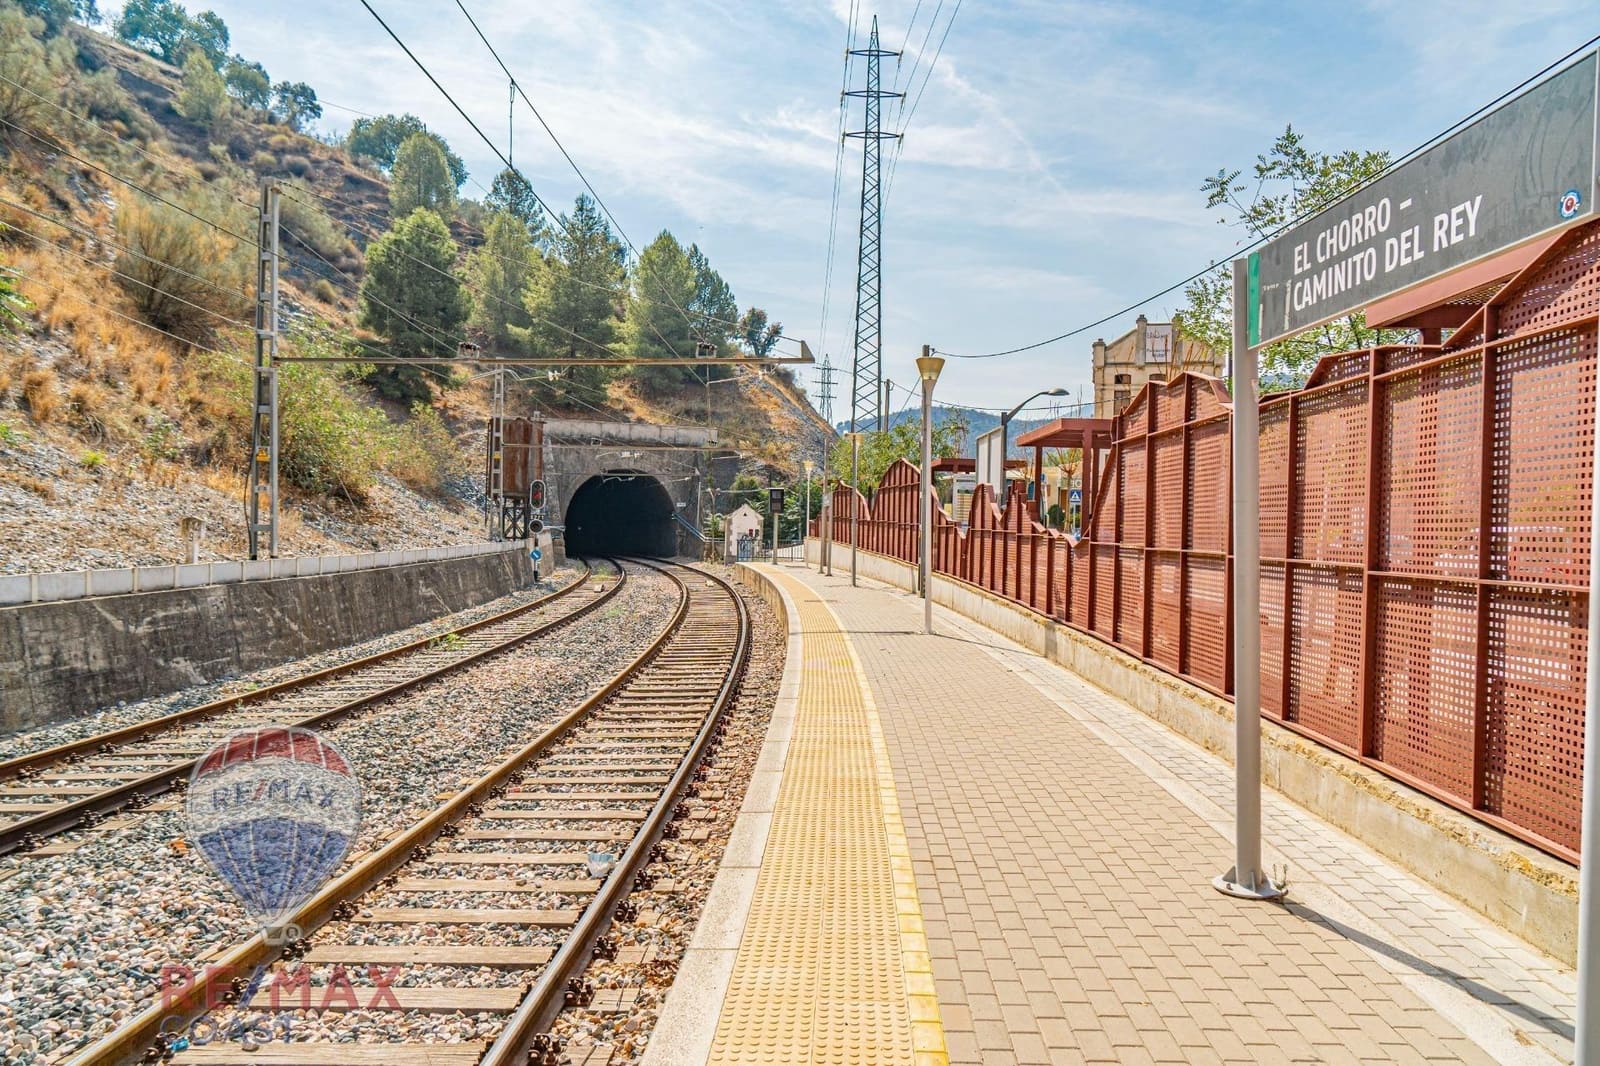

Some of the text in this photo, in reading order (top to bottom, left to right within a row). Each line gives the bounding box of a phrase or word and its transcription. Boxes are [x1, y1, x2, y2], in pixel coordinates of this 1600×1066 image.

[1293, 243, 1311, 276] EL
[1316, 197, 1391, 262] CHORRO
[1293, 194, 1483, 312] CAMINITO DEL REY
